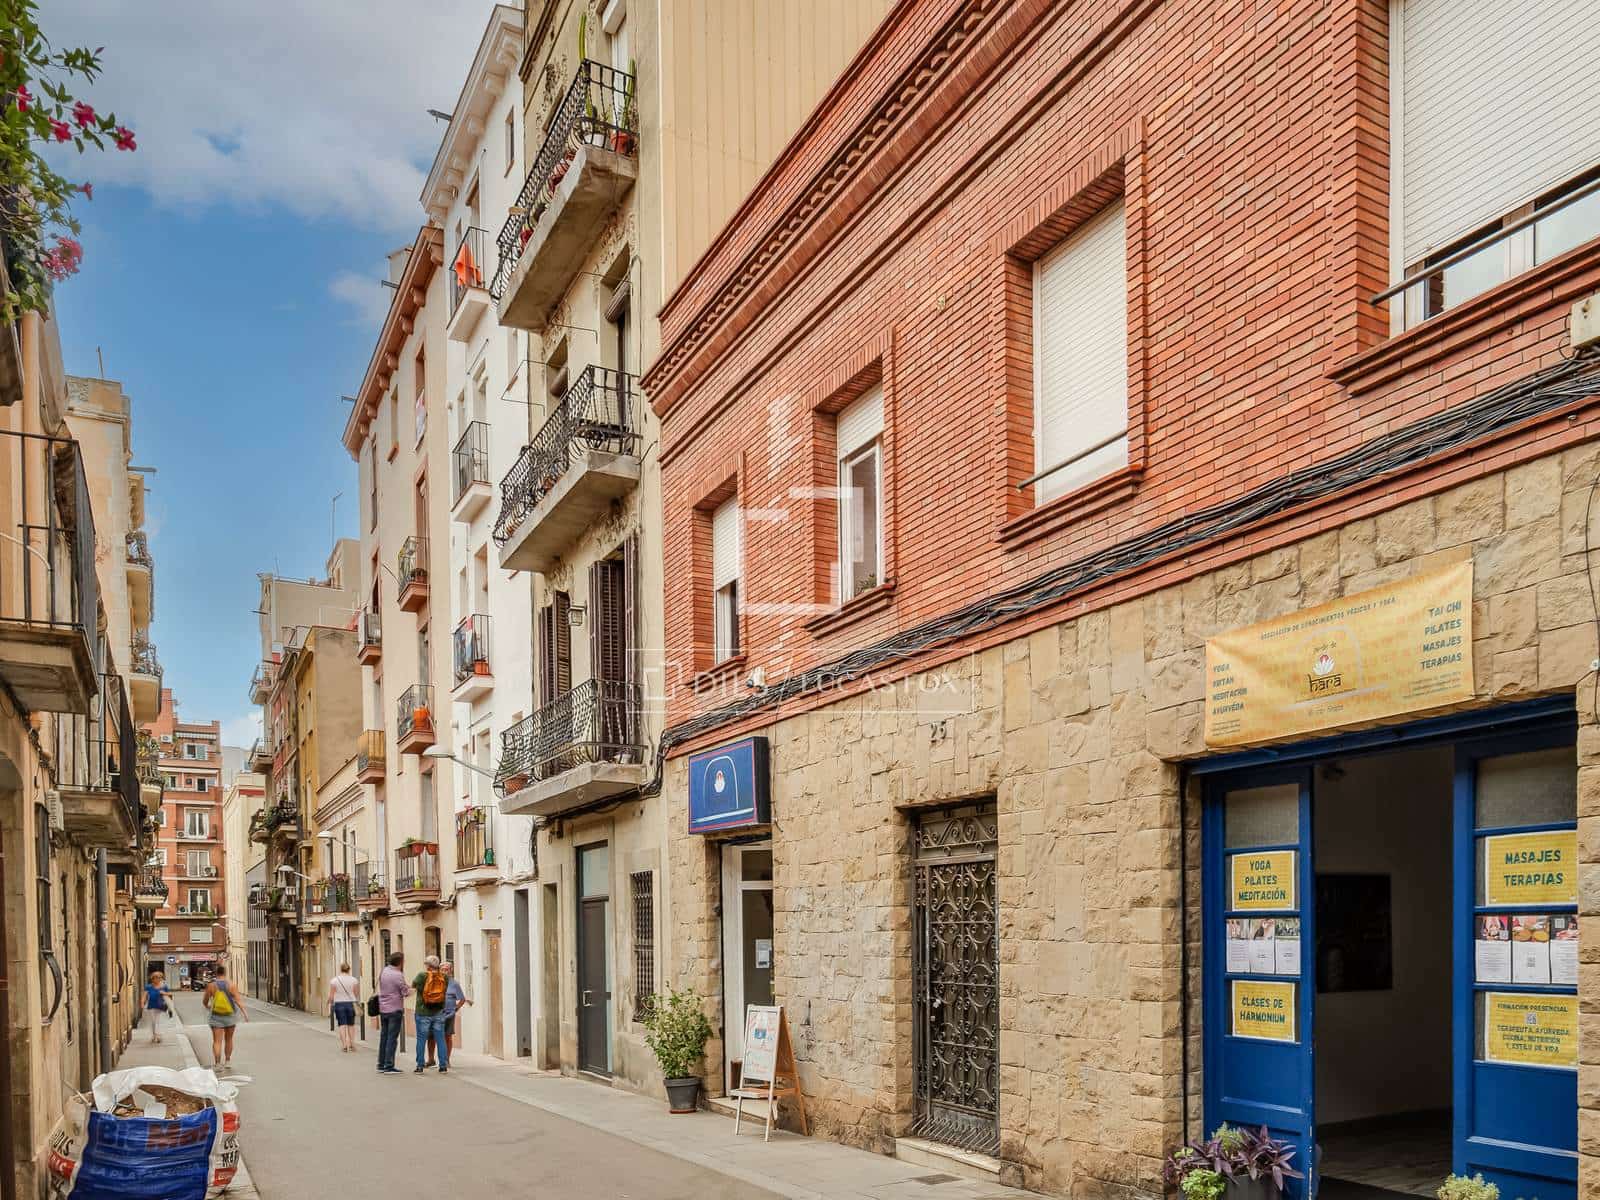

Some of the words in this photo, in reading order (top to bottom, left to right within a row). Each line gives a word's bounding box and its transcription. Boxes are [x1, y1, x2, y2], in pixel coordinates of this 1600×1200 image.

[1429, 606, 1443, 617] TAI
[1447, 600, 1462, 613] CHI
[1424, 619, 1462, 635] PILATES
[1423, 636, 1462, 653] MASAJES
[1421, 653, 1462, 670] TERAPIAS
[1307, 673, 1342, 693] hara
[1505, 850, 1561, 865] MASAJES
[1249, 860, 1271, 871] YOGA
[1244, 875, 1278, 886] PILATES
[1504, 872, 1564, 888] TERAPIAS
[1238, 888, 1286, 901] MEDITACIÓN
[1241, 996, 1271, 1008] CLASES
[1273, 998, 1284, 1009] DE
[1530, 1004, 1569, 1013] PRESENCIAL
[1240, 1010, 1286, 1024] HARMONIUM
